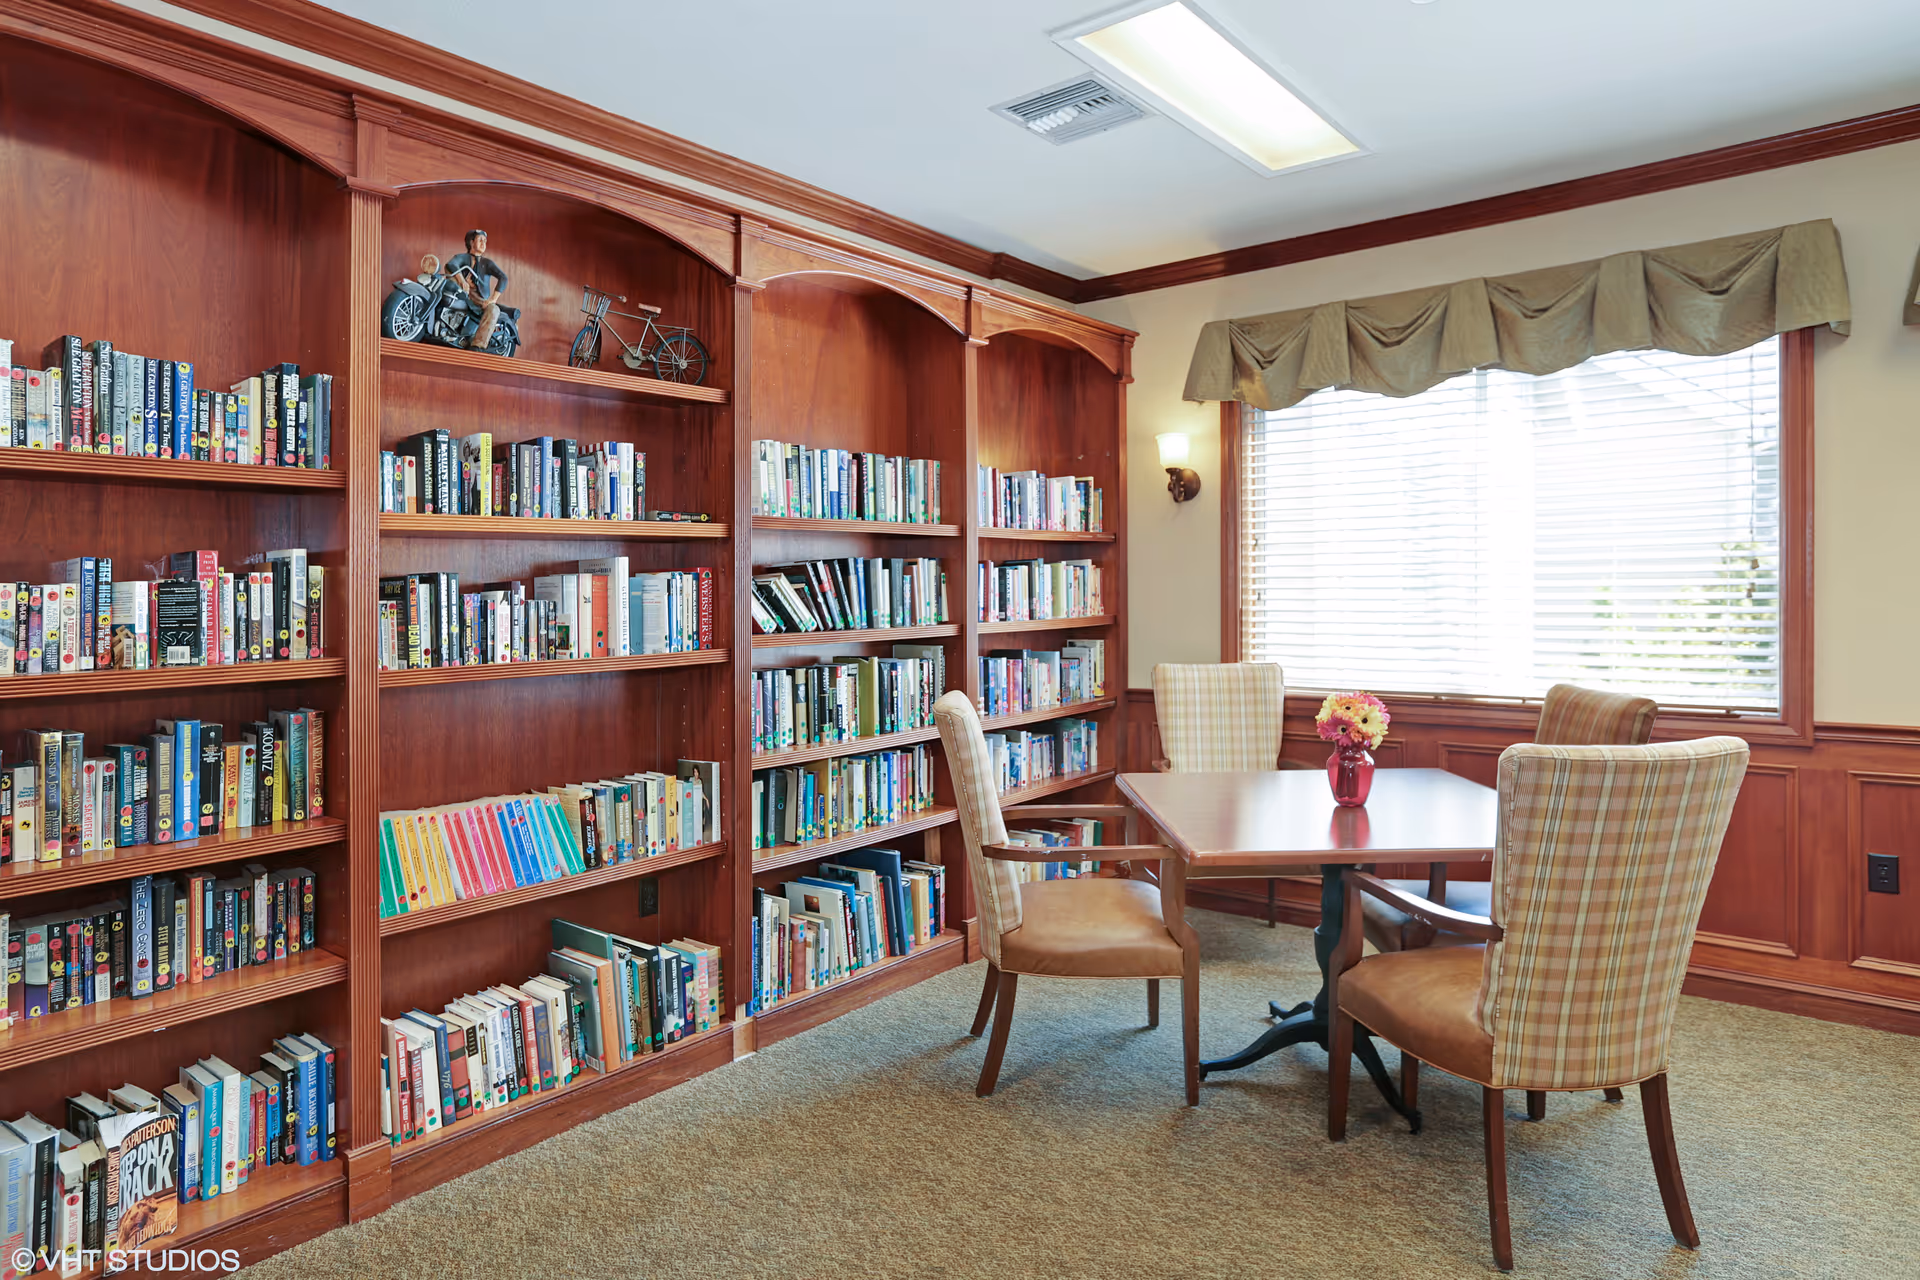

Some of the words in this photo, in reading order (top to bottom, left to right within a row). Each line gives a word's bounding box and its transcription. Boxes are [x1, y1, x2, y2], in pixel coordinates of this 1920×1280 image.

[71, 337, 82, 358] SUE
[100, 344, 112, 363] Sue
[100, 364, 112, 394] Grafton
[148, 360, 156, 373] SUE
[71, 358, 82, 404] GRAFTON
[82, 369, 93, 408] GRAFTON
[148, 374, 156, 408] GRAFTON
[163, 377, 171, 411] GRAFTON
[84, 572, 93, 586] JACK
[410, 606, 418, 625] WHITE
[408, 625, 420, 645] DEAD
[409, 646, 421, 667] TIME
[48, 742, 58, 778] BRENDA
[262, 731, 274, 772] KOONTZ
[228, 765, 236, 785] KAVA
[47, 780, 58, 804] JOYCE
[159, 794, 171, 816] GONE
[72, 795, 80, 822] MOSES
[84, 804, 92, 839] SACRIFICE
[136, 878, 147, 899] THE
[136, 902, 148, 930] ZERO
[158, 926, 168, 944] STEVE
[640, 967, 648, 1008] JERUSALEM
[307, 1058, 317, 1086] EMILIE
[442, 1070, 452, 1088] 1776
[308, 1086, 317, 1128] RICHARDS
[130, 1117, 176, 1150] PATTERSON
[138, 1139, 158, 1165] ON
[158, 1133, 174, 1160] A
[106, 1171, 119, 1206] PATTERSON
